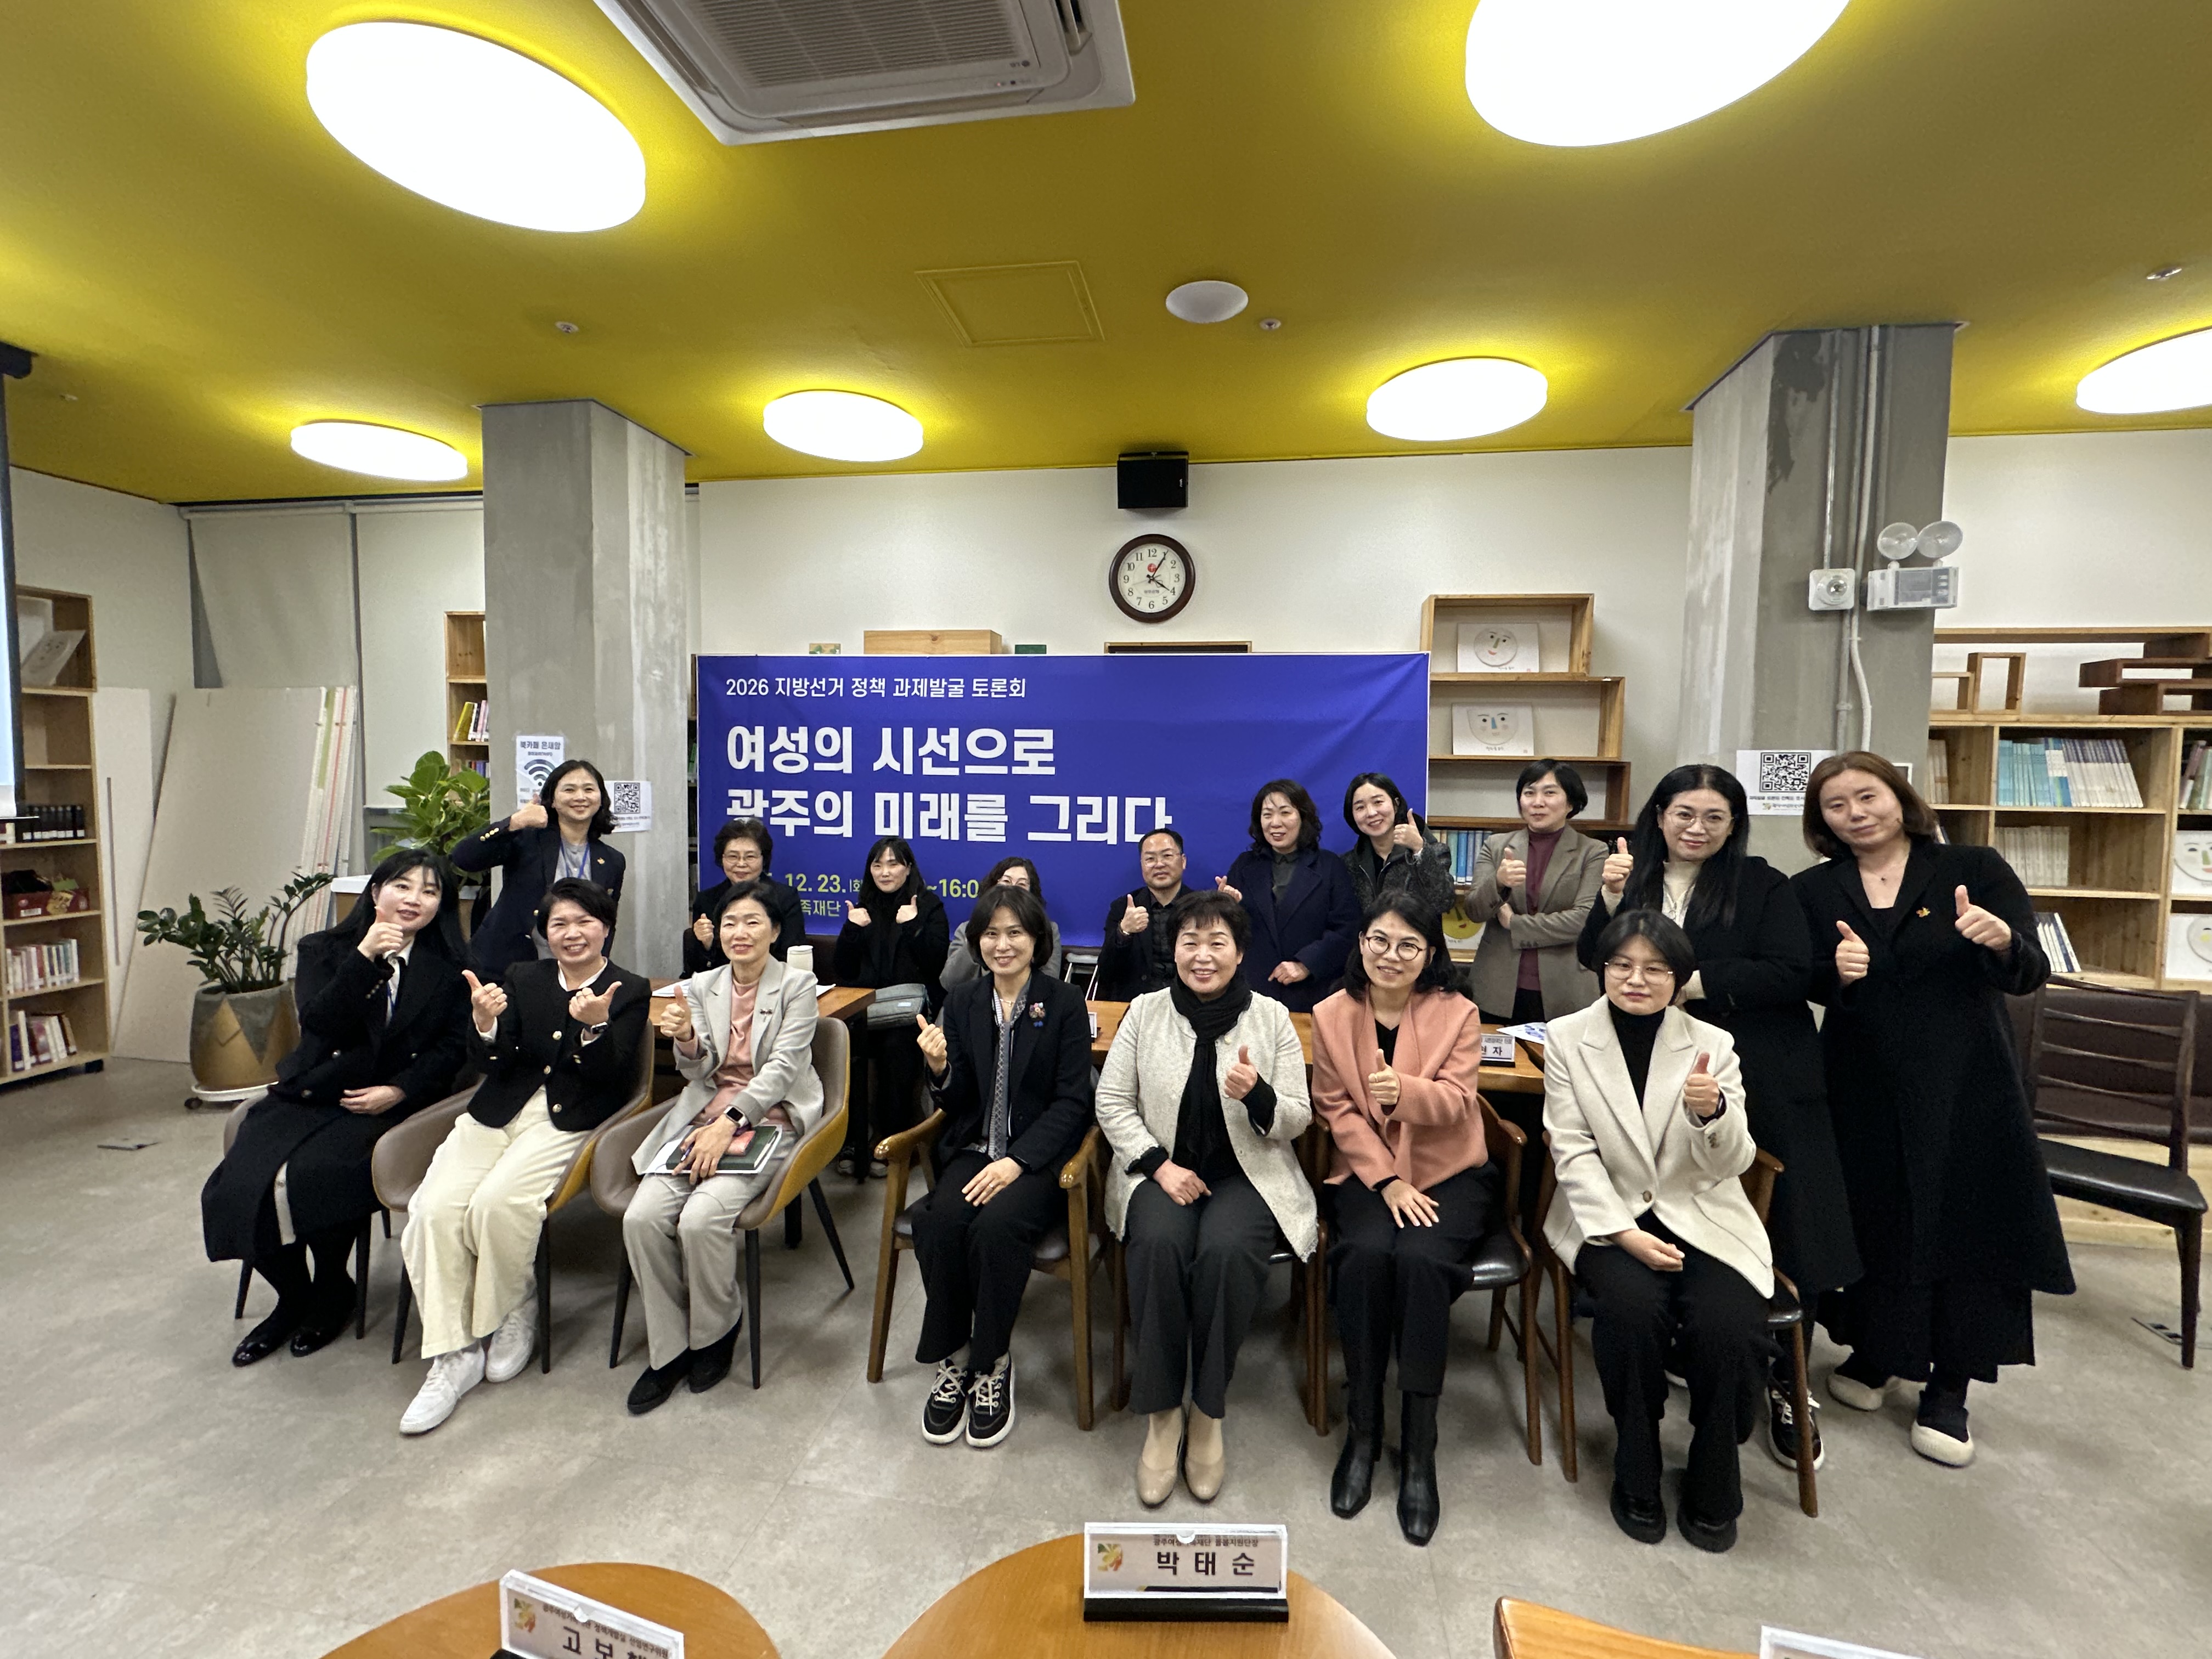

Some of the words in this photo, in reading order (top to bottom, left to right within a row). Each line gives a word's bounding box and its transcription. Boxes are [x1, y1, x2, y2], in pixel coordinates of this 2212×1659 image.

[1136, 552, 1143, 561] 11
[1148, 549, 1157, 557] 12
[1127, 562, 1135, 571] 10
[1170, 560, 1176, 569] 2
[1124, 575, 1130, 584] 9
[1174, 573, 1180, 583] 3
[1127, 588, 1133, 596] 8
[1170, 586, 1176, 596] 4
[1136, 597, 1142, 606] 7
[1163, 596, 1168, 605] 5
[1148, 601, 1155, 610] 6
[726, 678, 769, 696] 2026
[775, 677, 844, 697] 지방선거
[851, 677, 885, 698] 정책
[893, 678, 965, 698] 과제발굴
[971, 678, 1026, 698] 토론회
[727, 725, 853, 774] 여성의
[873, 727, 1056, 776] 시선으로
[726, 789, 853, 838] 광주의
[874, 792, 1008, 843] 미래를
[1027, 795, 1173, 845] 그리다
[817, 874, 846, 893] 23.
[1157, 1551, 1180, 1576] 박
[1194, 1552, 1216, 1576] 태
[1232, 1553, 1254, 1576] 순
[562, 1625, 582, 1656] 고
